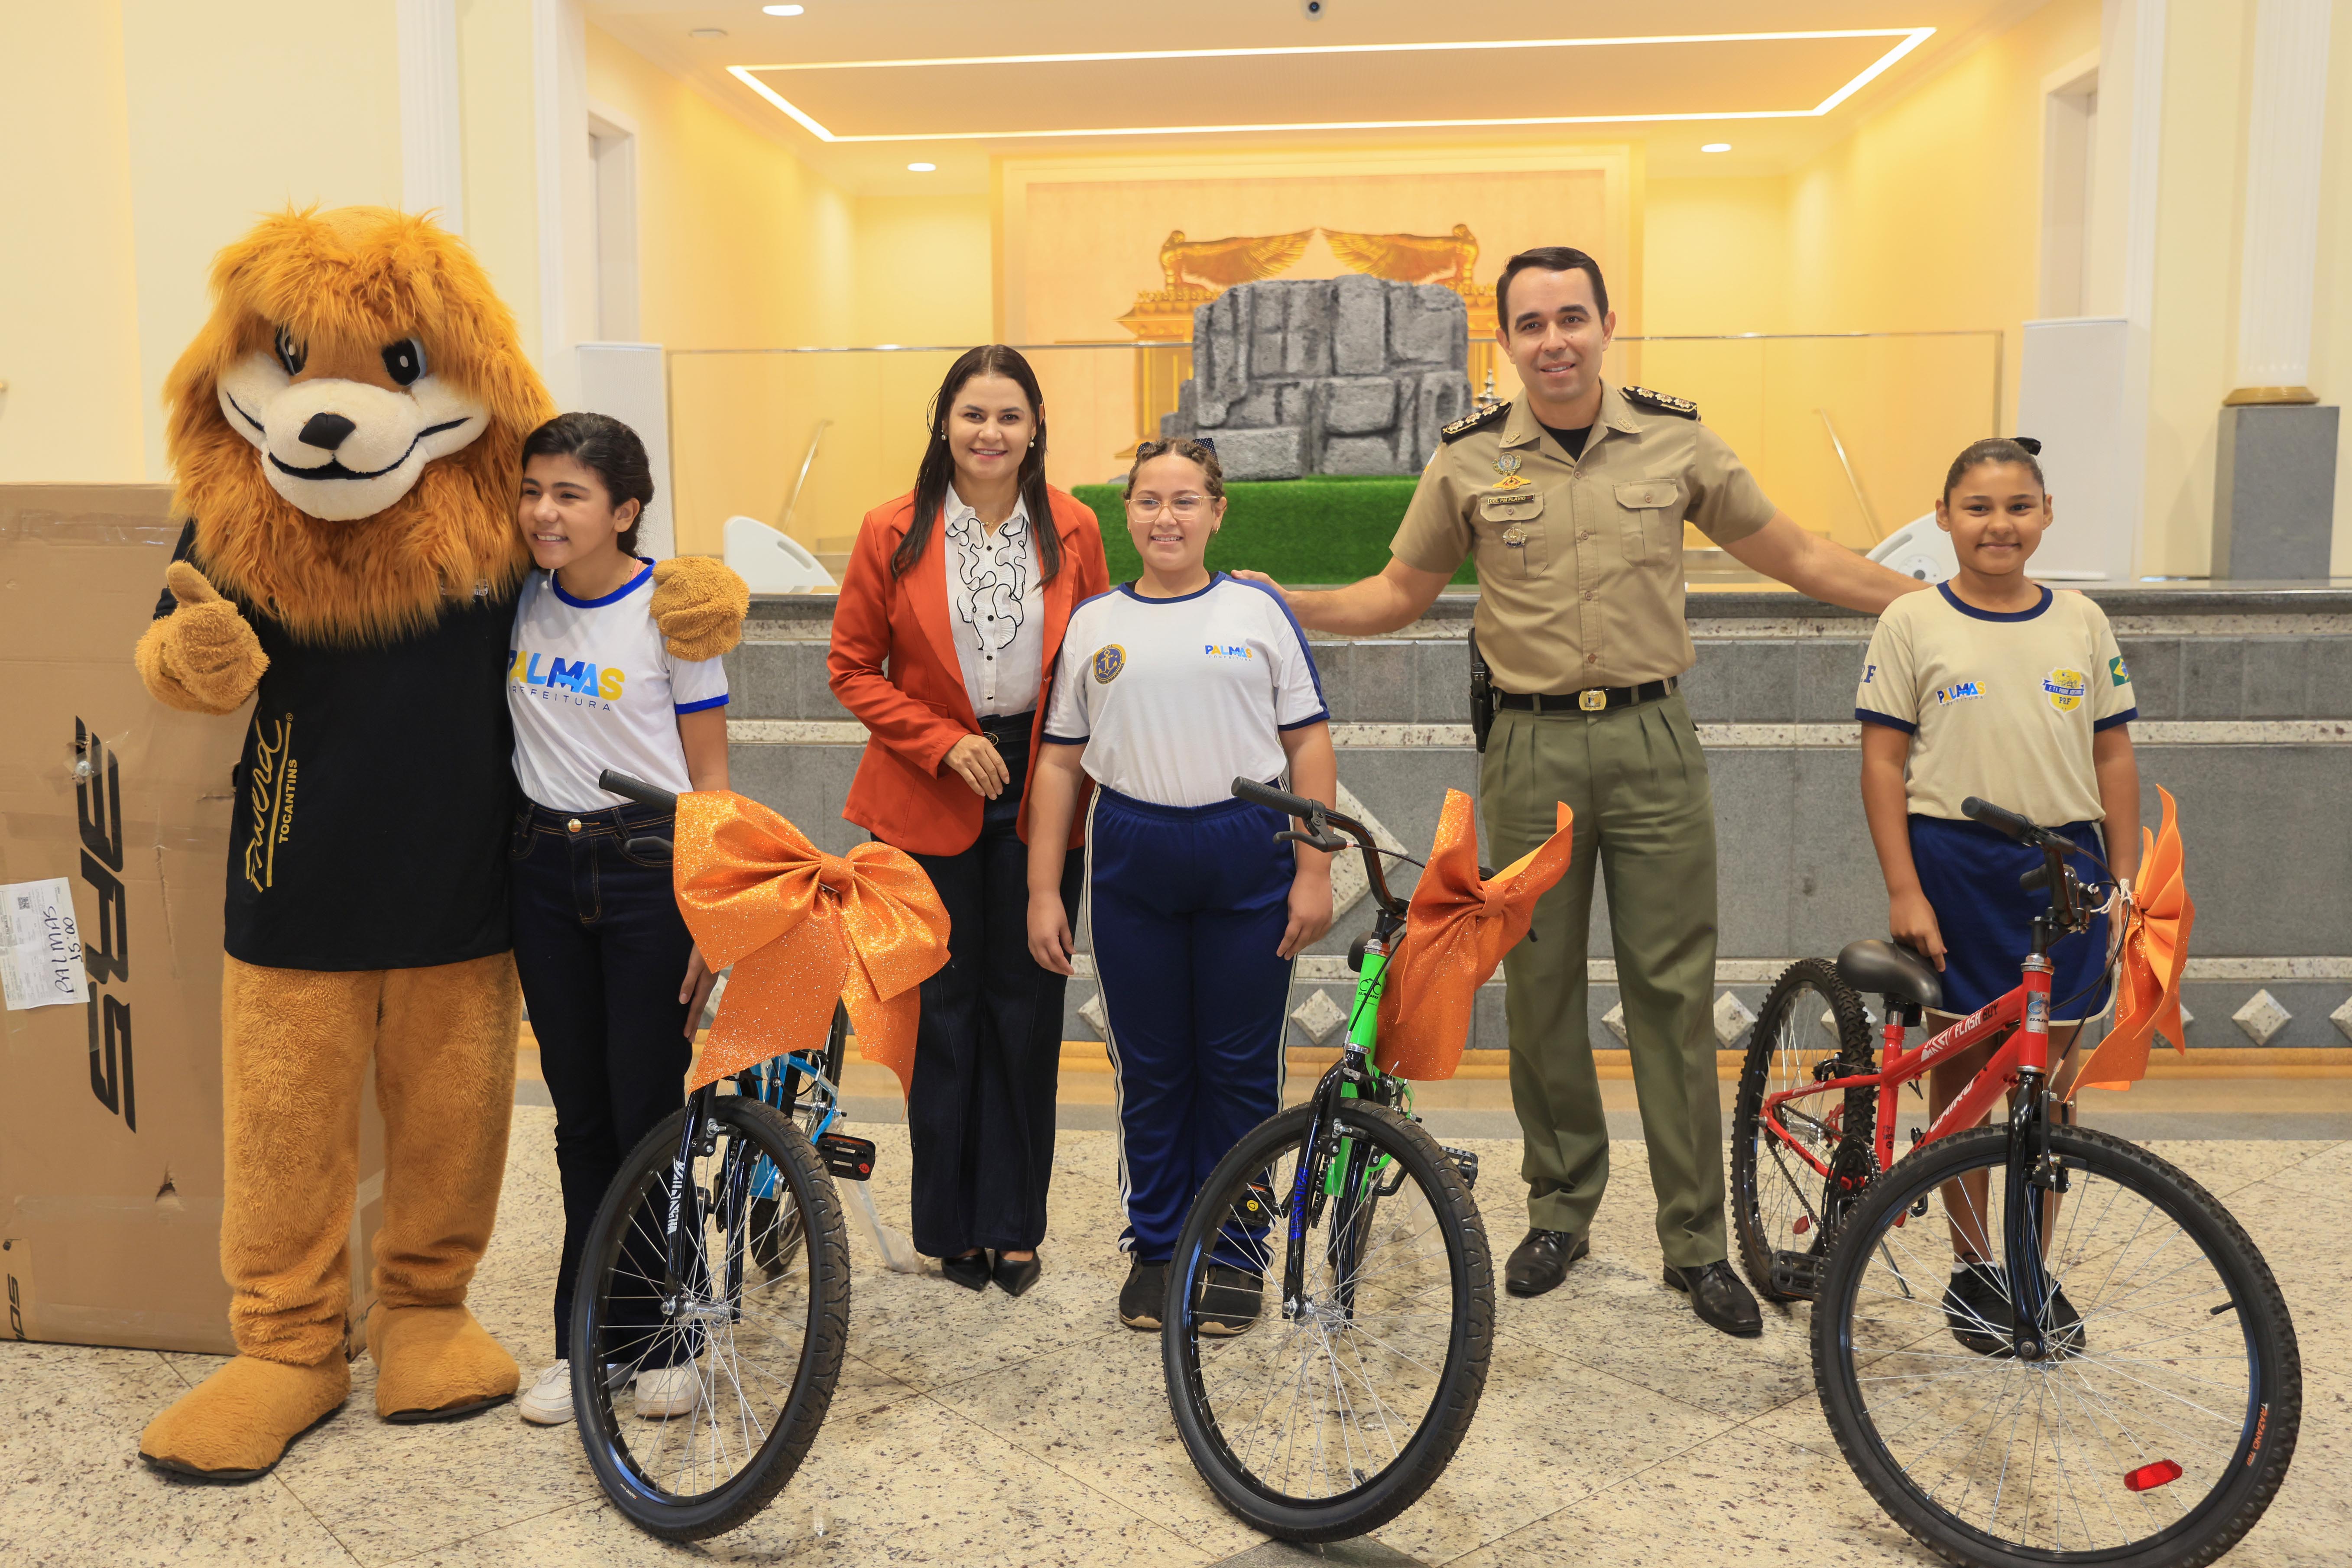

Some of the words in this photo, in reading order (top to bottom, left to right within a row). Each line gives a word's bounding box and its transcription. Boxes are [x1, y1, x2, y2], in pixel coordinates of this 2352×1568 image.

[1205, 645, 1252, 658] PALMAS
[509, 650, 625, 701] PALMAS
[1936, 681, 1986, 703] PALMAS
[509, 685, 610, 711] REFEITURA
[2059, 697, 2072, 705] PRF
[279, 759, 297, 843] TOCANTINS
[43, 906, 75, 993] PALMAS
[63, 917, 83, 963] 15:00
[1954, 1010, 1982, 1038] FLASH
[1982, 1000, 2000, 1022] BOY
[2252, 1403, 2268, 1449] TRAZANO
[625, 1489, 638, 1500] TRAZANO
